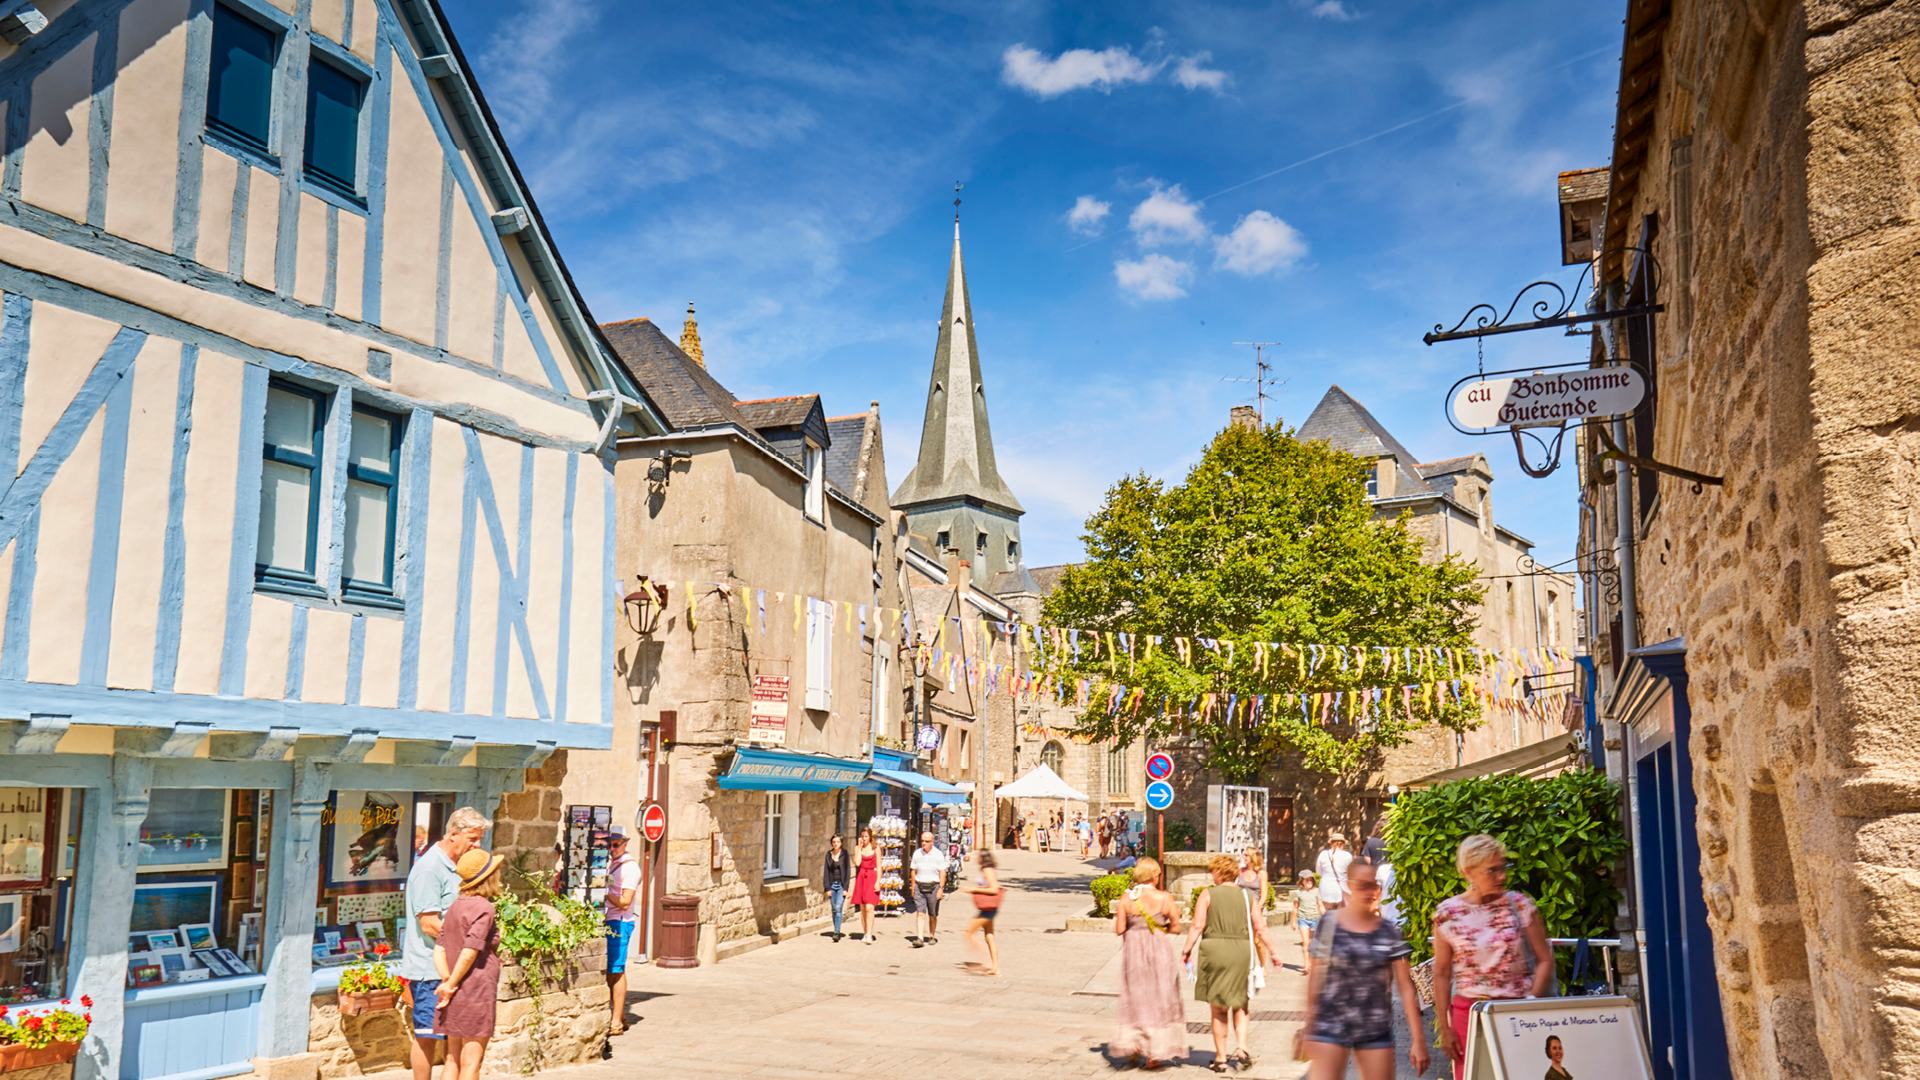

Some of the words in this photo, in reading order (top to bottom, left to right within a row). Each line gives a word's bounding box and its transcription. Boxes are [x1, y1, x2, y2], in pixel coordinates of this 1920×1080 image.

[1468, 388, 1491, 403] au
[1511, 372, 1630, 399] Bonhomme
[1498, 396, 1597, 423] Guérande
[737, 763, 774, 775] PRODUITS
[771, 765, 782, 776] DE
[781, 766, 792, 776] LA
[791, 767, 806, 777] MER
[814, 768, 839, 779] VENTE
[835, 770, 866, 782] DIRECTE
[320, 802, 372, 833] ourquoi
[1519, 1019, 1538, 1032] Papa
[1539, 1018, 1560, 1031] Pique
[1561, 1017, 1569, 1026] et
[1569, 1016, 1598, 1025] Maman
[1599, 1013, 1619, 1024] Coud
